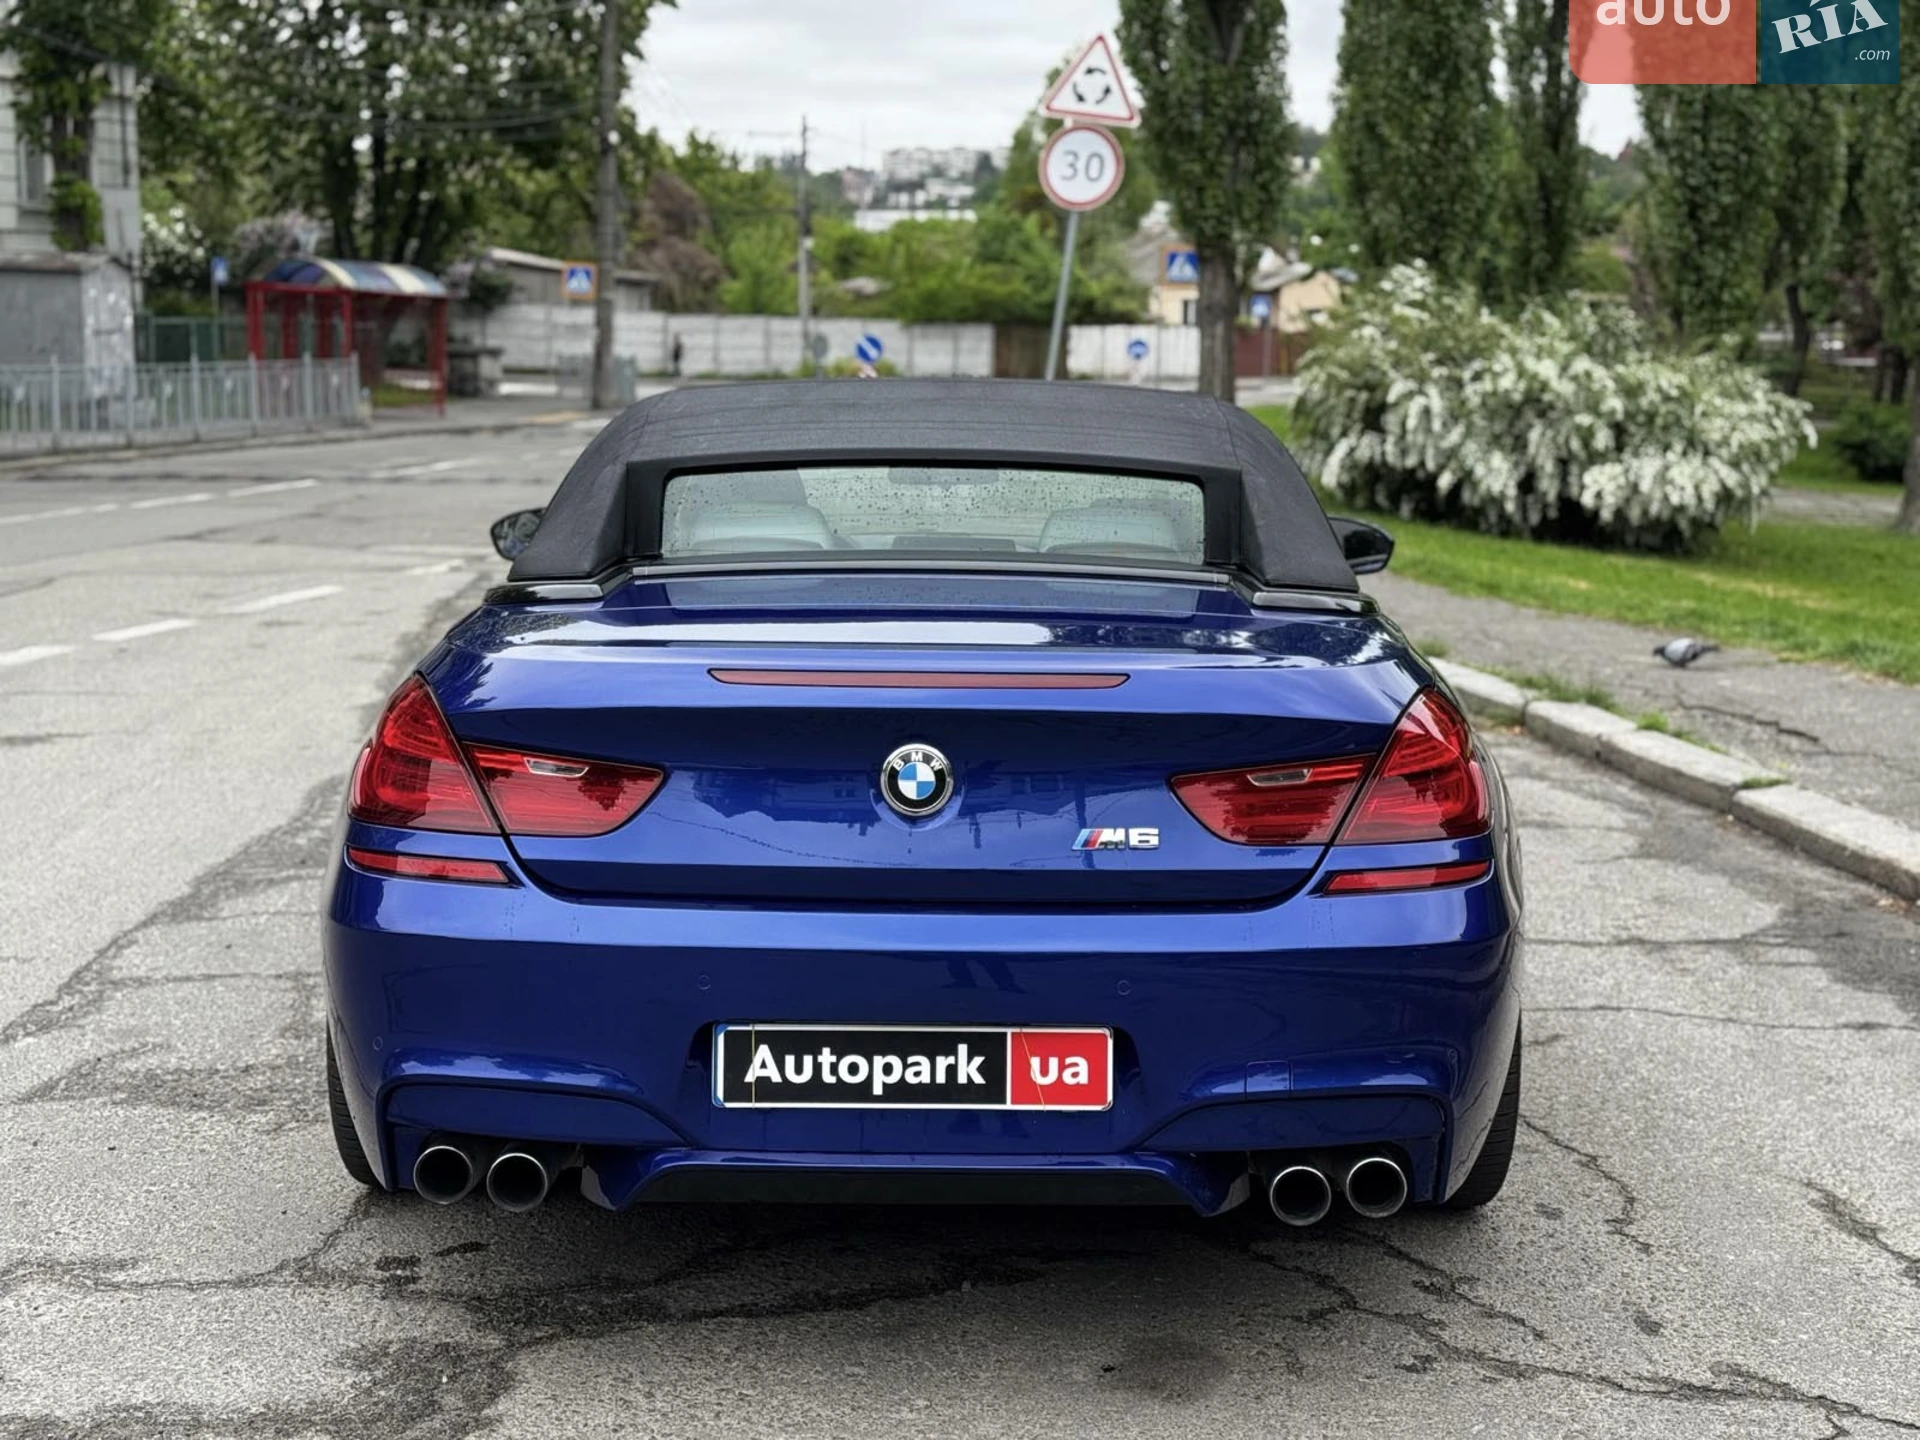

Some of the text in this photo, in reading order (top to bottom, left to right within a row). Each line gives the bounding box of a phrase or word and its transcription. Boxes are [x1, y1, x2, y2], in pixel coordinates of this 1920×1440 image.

[1060, 149, 1105, 182] 30
[892, 751, 943, 771] BMW
[1095, 828, 1160, 849] M6
[743, 1043, 1090, 1096] Autopark ua
